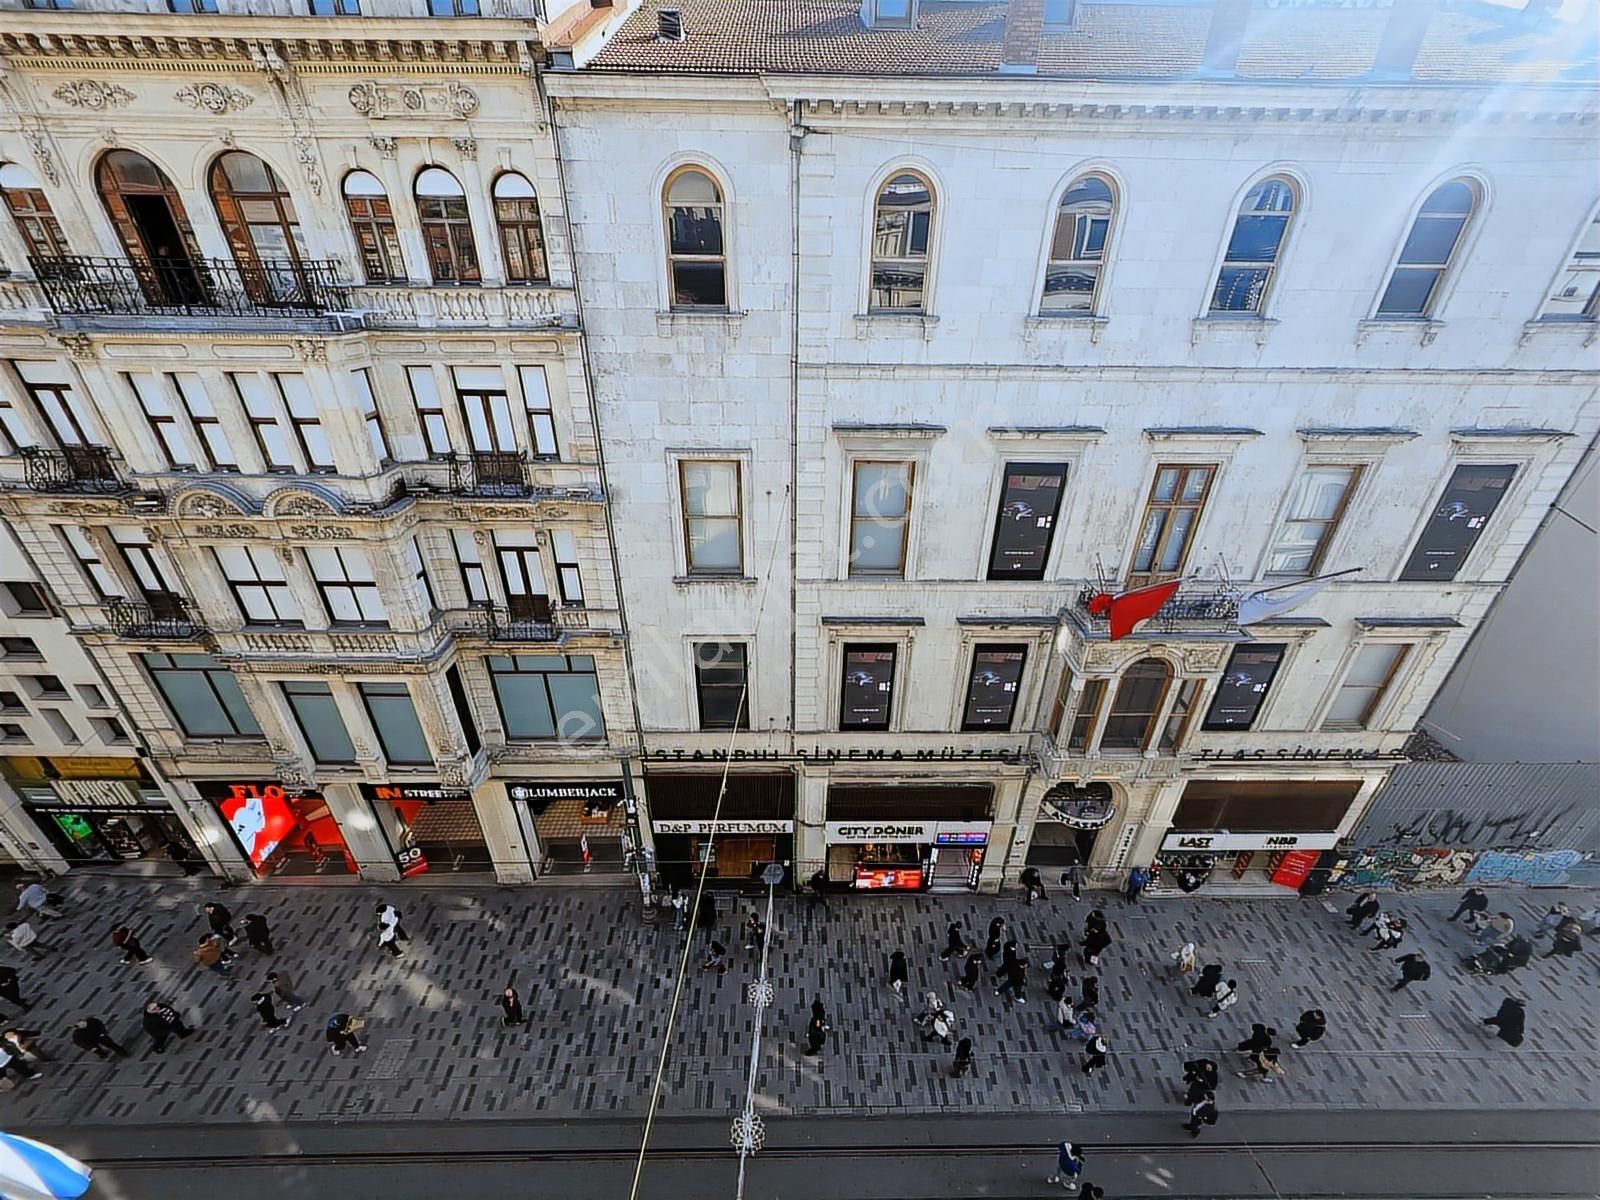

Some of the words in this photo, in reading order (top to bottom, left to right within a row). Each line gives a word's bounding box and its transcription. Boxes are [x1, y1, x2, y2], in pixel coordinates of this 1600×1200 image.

[529, 787, 617, 798] LUMBERJACK
[660, 823, 692, 833] D&P
[698, 823, 787, 833] PERFUMUM
[838, 826, 871, 835] CITY
[873, 825, 924, 835] DÖNER
[398, 847, 421, 863] 50
